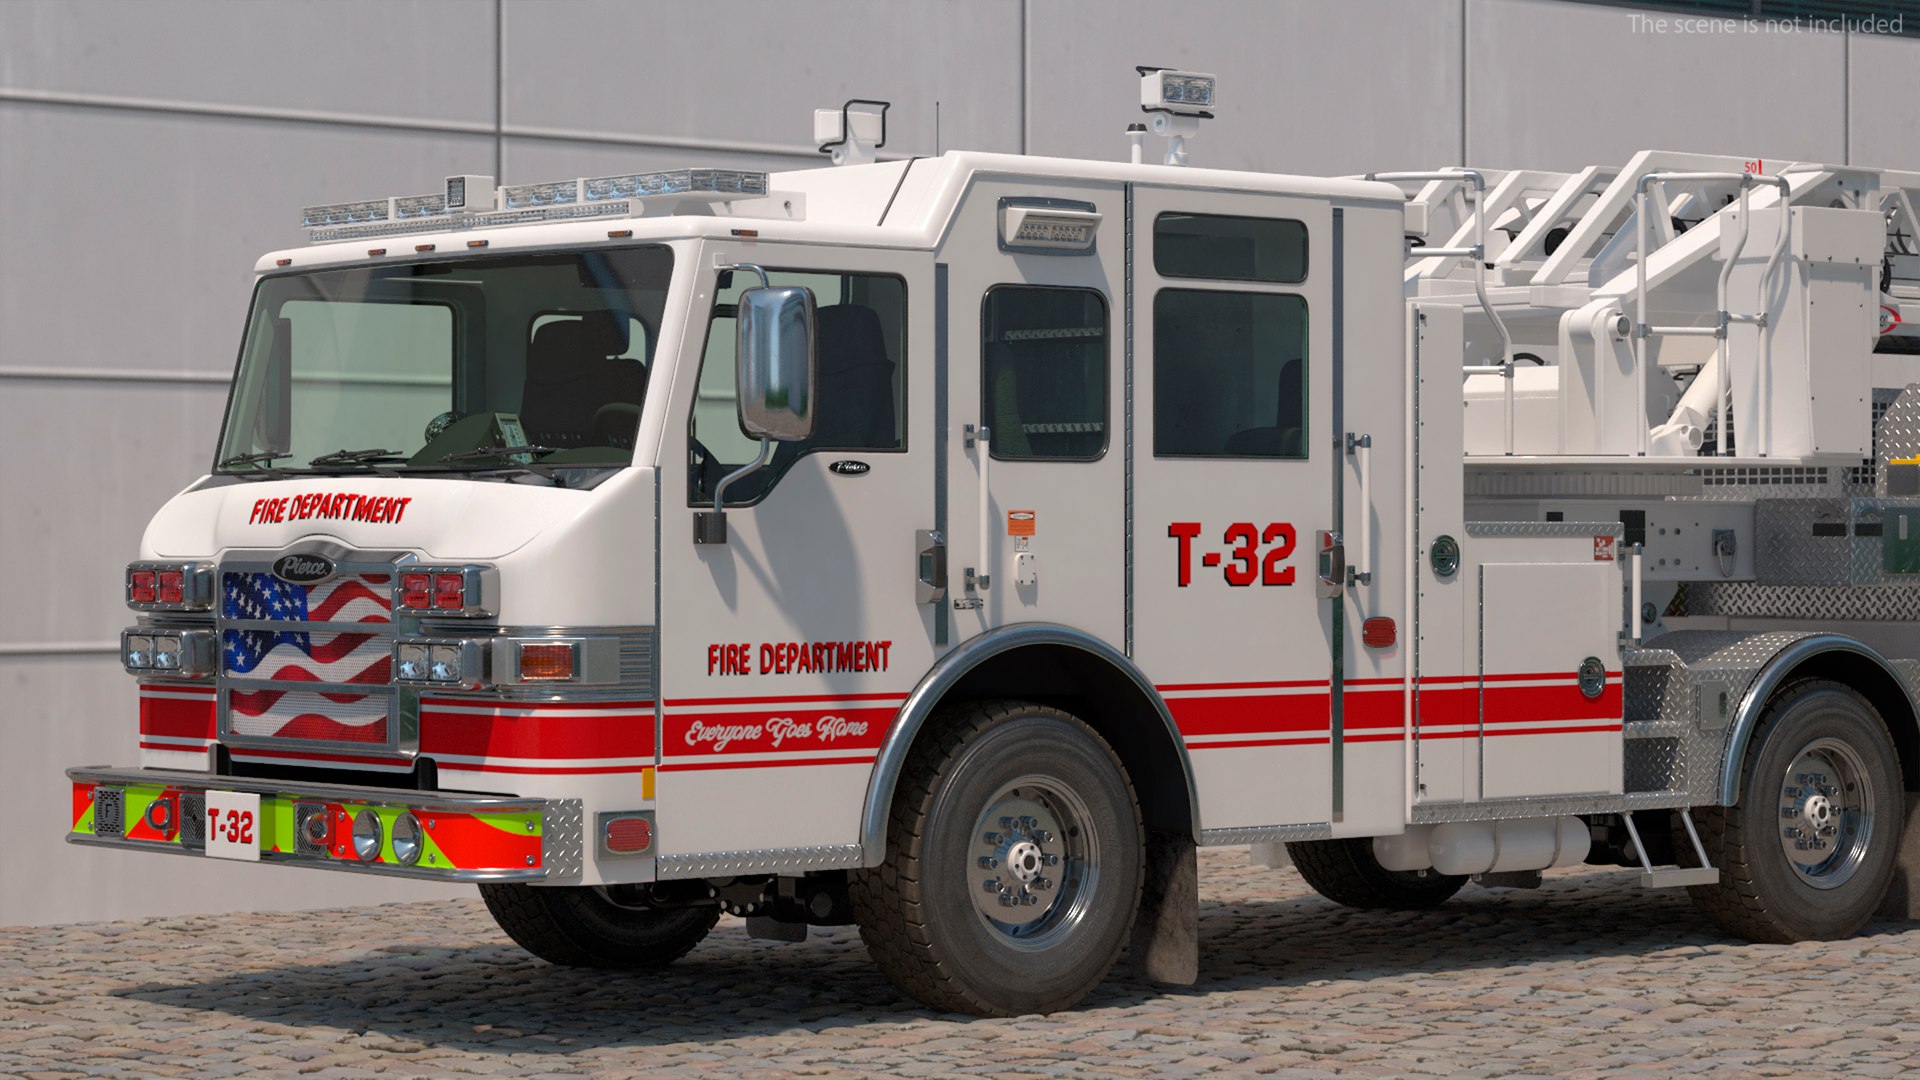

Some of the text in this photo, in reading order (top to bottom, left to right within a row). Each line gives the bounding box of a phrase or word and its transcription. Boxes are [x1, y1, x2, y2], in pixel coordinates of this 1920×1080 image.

[1745, 162, 1757, 174] 50
[249, 492, 412, 525] FIRE DEPARTMENT
[281, 556, 325, 578] Pierce
[1168, 522, 1297, 587] T-32
[708, 640, 892, 676] FIRE DEPARTMENT
[685, 715, 869, 752] Everyone Goes Home
[207, 807, 253, 844] T-32
